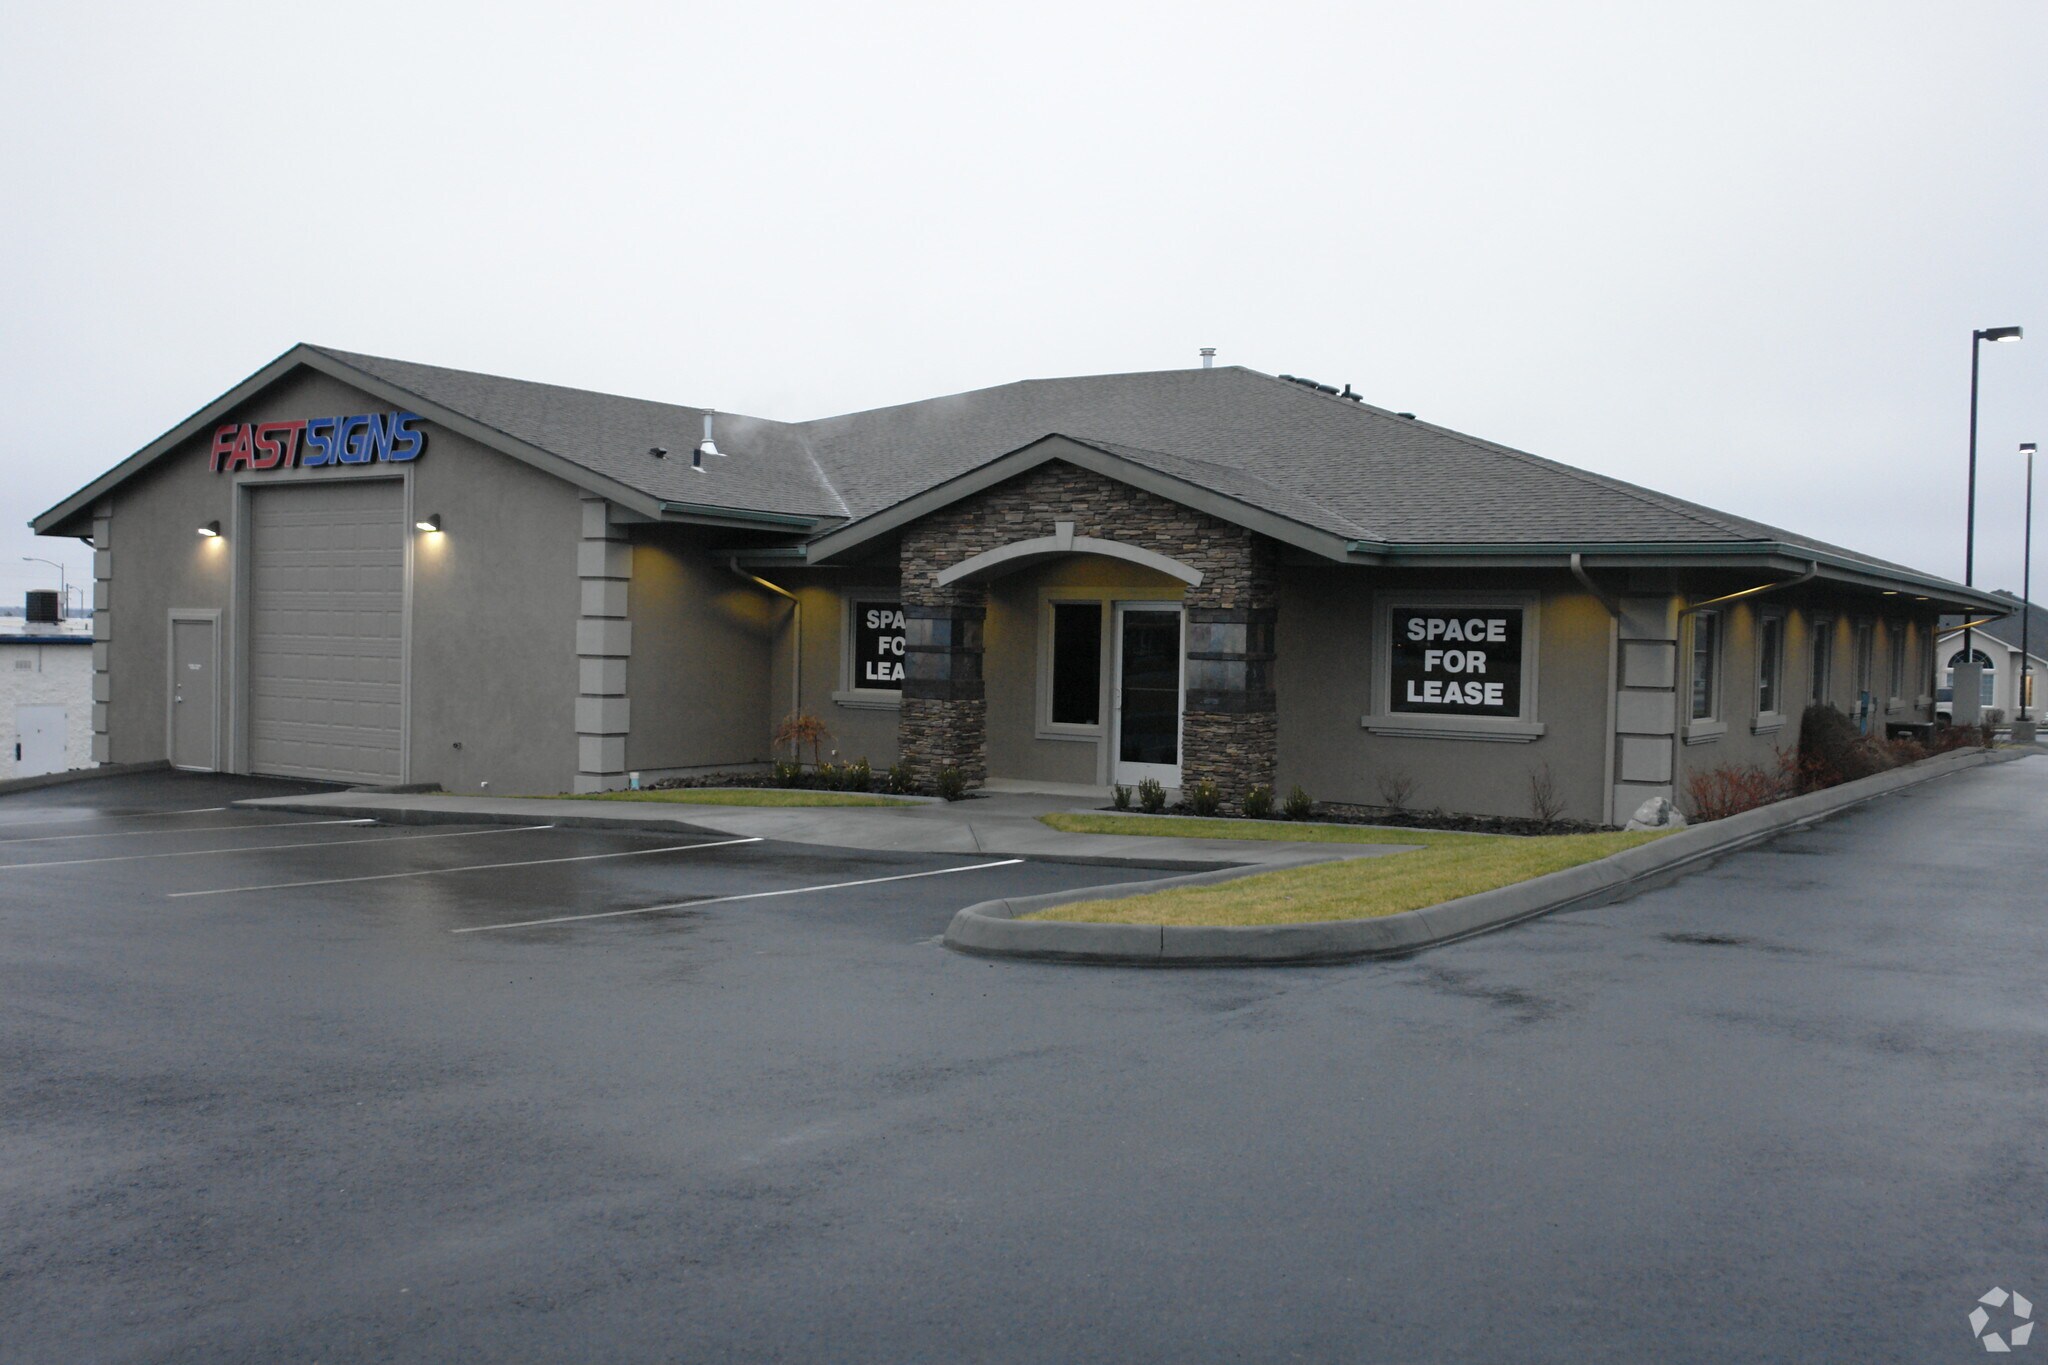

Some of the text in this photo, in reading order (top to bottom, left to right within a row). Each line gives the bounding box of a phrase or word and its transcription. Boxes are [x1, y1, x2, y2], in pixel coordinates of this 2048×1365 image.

[209, 412, 426, 471] FASTSIGNS
[1407, 618, 1506, 642] SPACE
[1424, 649, 1487, 673] FOR
[1407, 680, 1504, 705] LEASE
